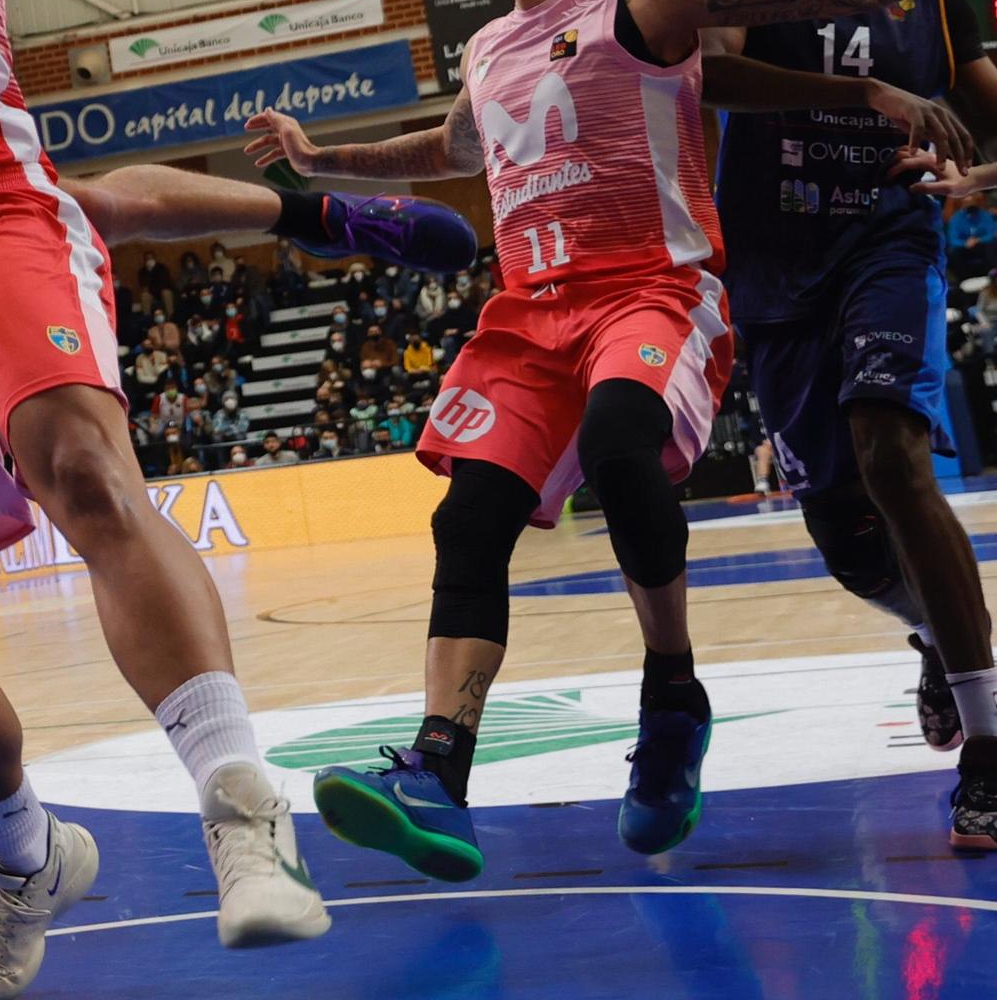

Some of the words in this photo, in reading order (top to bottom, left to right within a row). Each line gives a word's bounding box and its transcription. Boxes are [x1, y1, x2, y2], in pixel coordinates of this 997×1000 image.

[289, 15, 329, 32] Unicaja
[331, 10, 364, 25] Banco
[158, 40, 198, 56] Unicaja
[198, 35, 230, 48] Banco
[817, 23, 874, 76] 14
[124, 98, 216, 141] capital
[224, 89, 265, 121] del
[275, 72, 375, 114] deporte
[810, 109, 874, 128] Unicaja
[523, 221, 571, 274] 11
[867, 331, 913, 344] OVIEDO
[436, 387, 491, 442] hp
